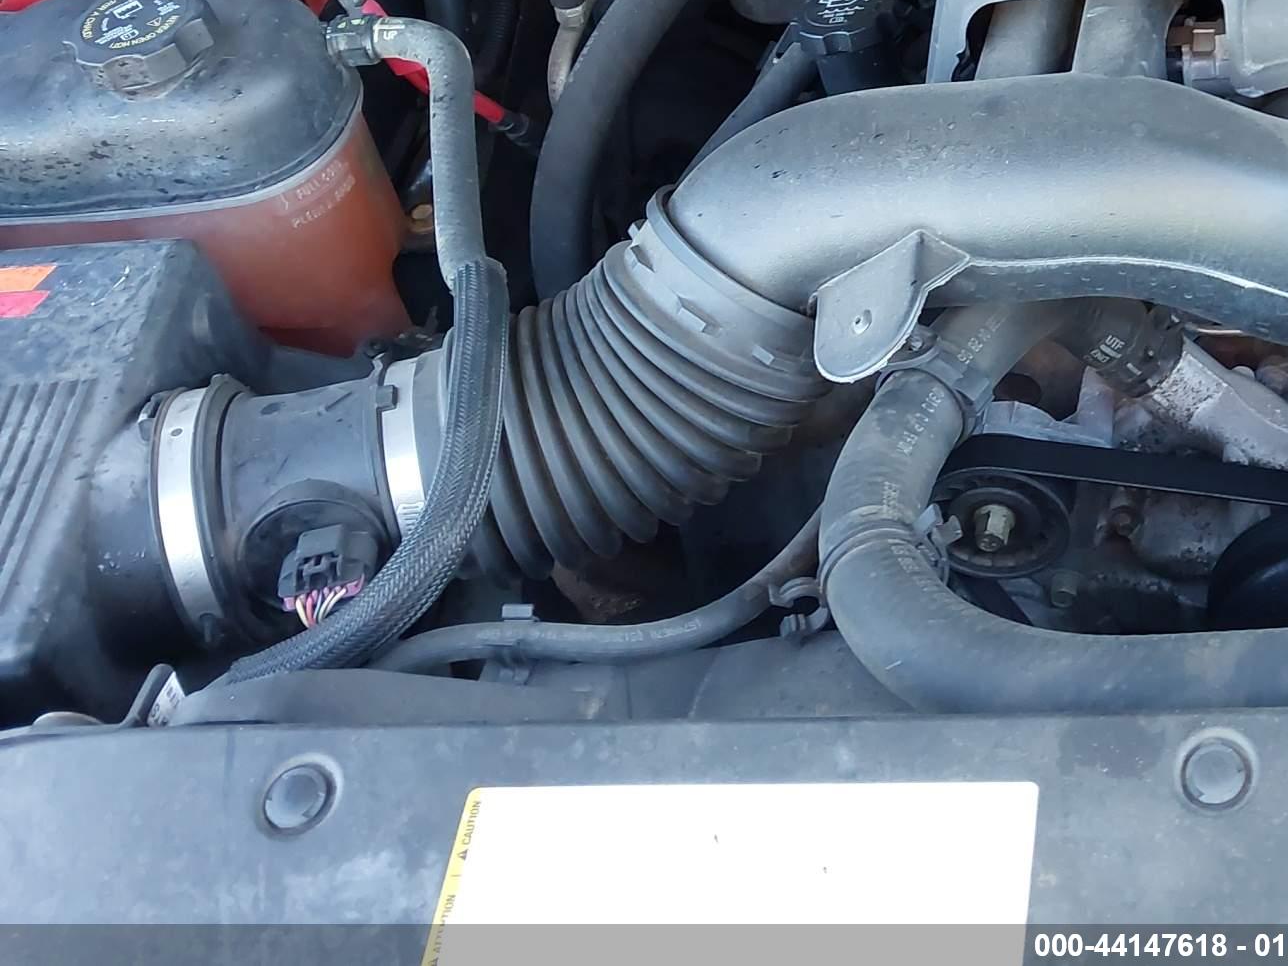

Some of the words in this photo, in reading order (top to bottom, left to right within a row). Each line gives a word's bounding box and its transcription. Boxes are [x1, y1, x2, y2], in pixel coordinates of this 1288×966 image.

[131, 32, 157, 46] OPEN
[1104, 334, 1126, 351] UTF
[461, 800, 482, 846] CAUTION
